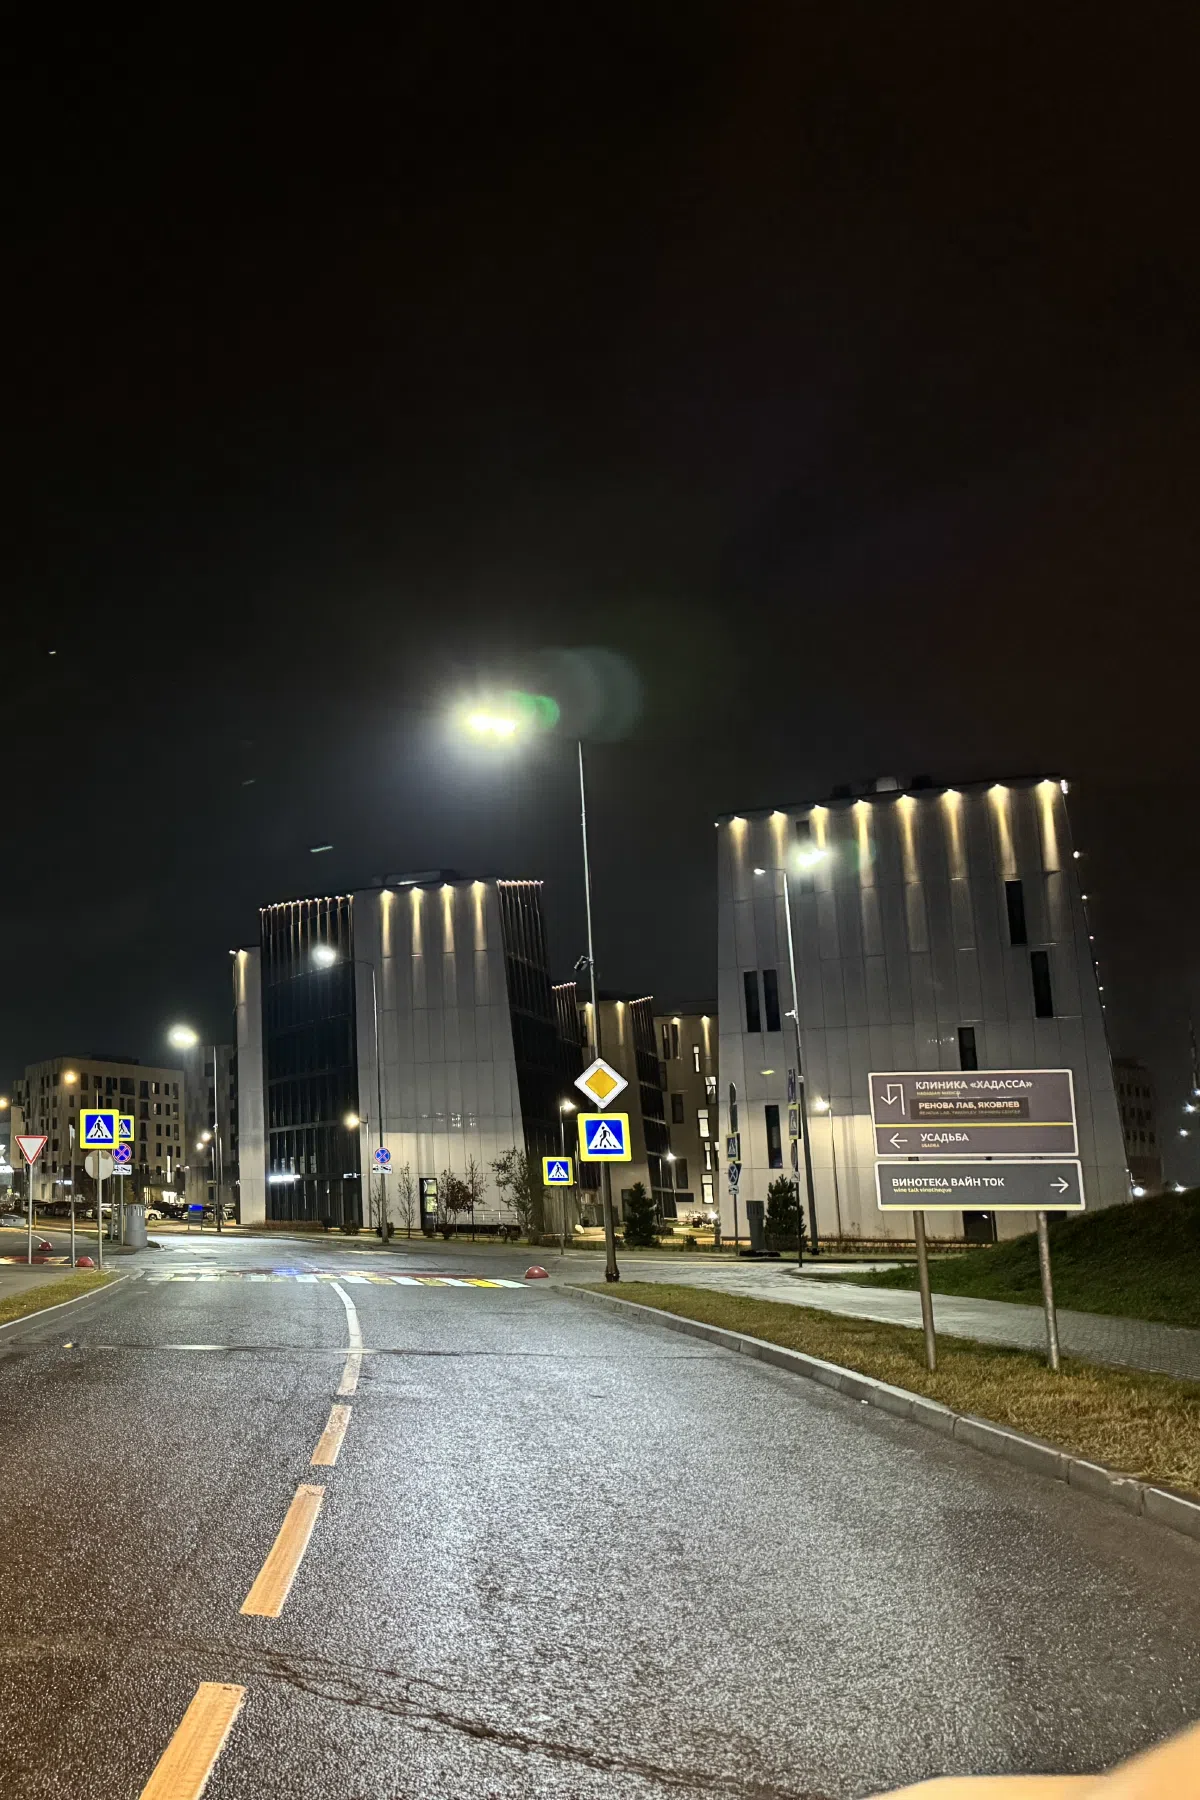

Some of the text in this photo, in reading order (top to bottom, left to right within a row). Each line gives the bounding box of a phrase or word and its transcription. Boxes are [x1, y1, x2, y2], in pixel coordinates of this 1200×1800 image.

[915, 1080, 1033, 1090] КЛИНИКА «ХАДАССА»
[955, 1101, 977, 1109] ЛАБ,
[920, 1133, 970, 1143] УСАДЬБА
[892, 1176, 1005, 1187] ВИНОТЕКА ВАЙН ТОК
